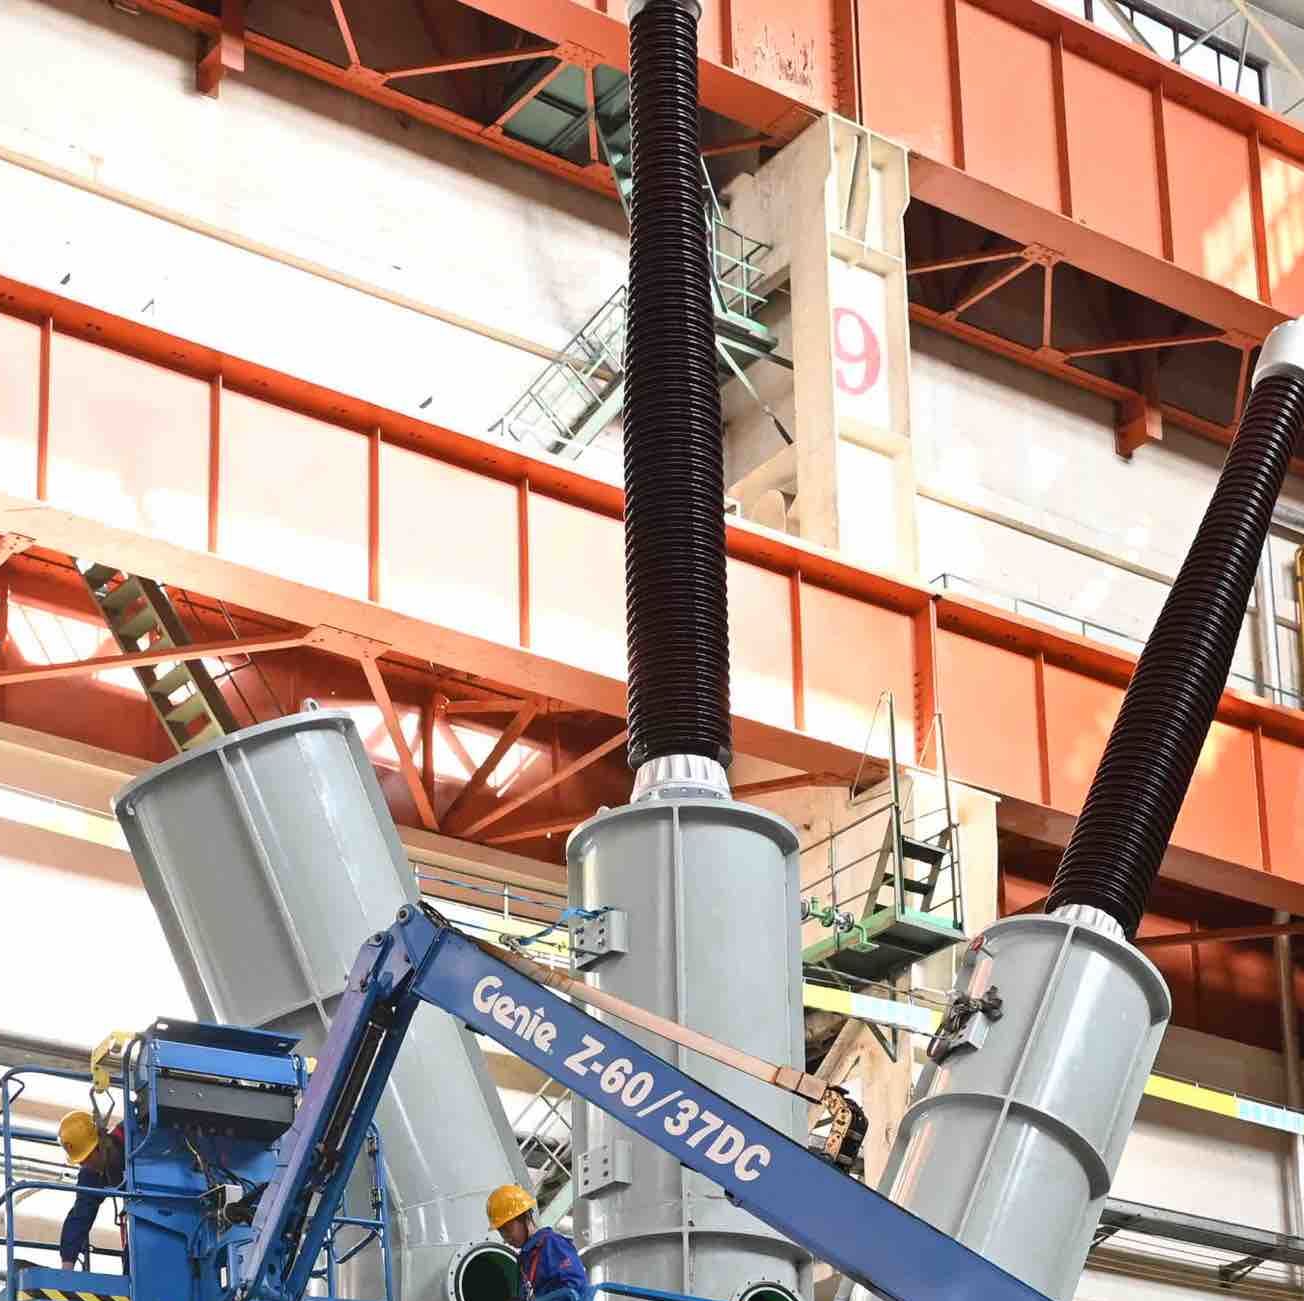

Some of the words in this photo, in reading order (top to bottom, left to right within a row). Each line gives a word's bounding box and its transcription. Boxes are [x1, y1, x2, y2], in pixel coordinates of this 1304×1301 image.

[832, 307, 880, 396] 9
[473, 975, 557, 1051] Genie
[563, 1034, 771, 1182] Z-60/37DC
